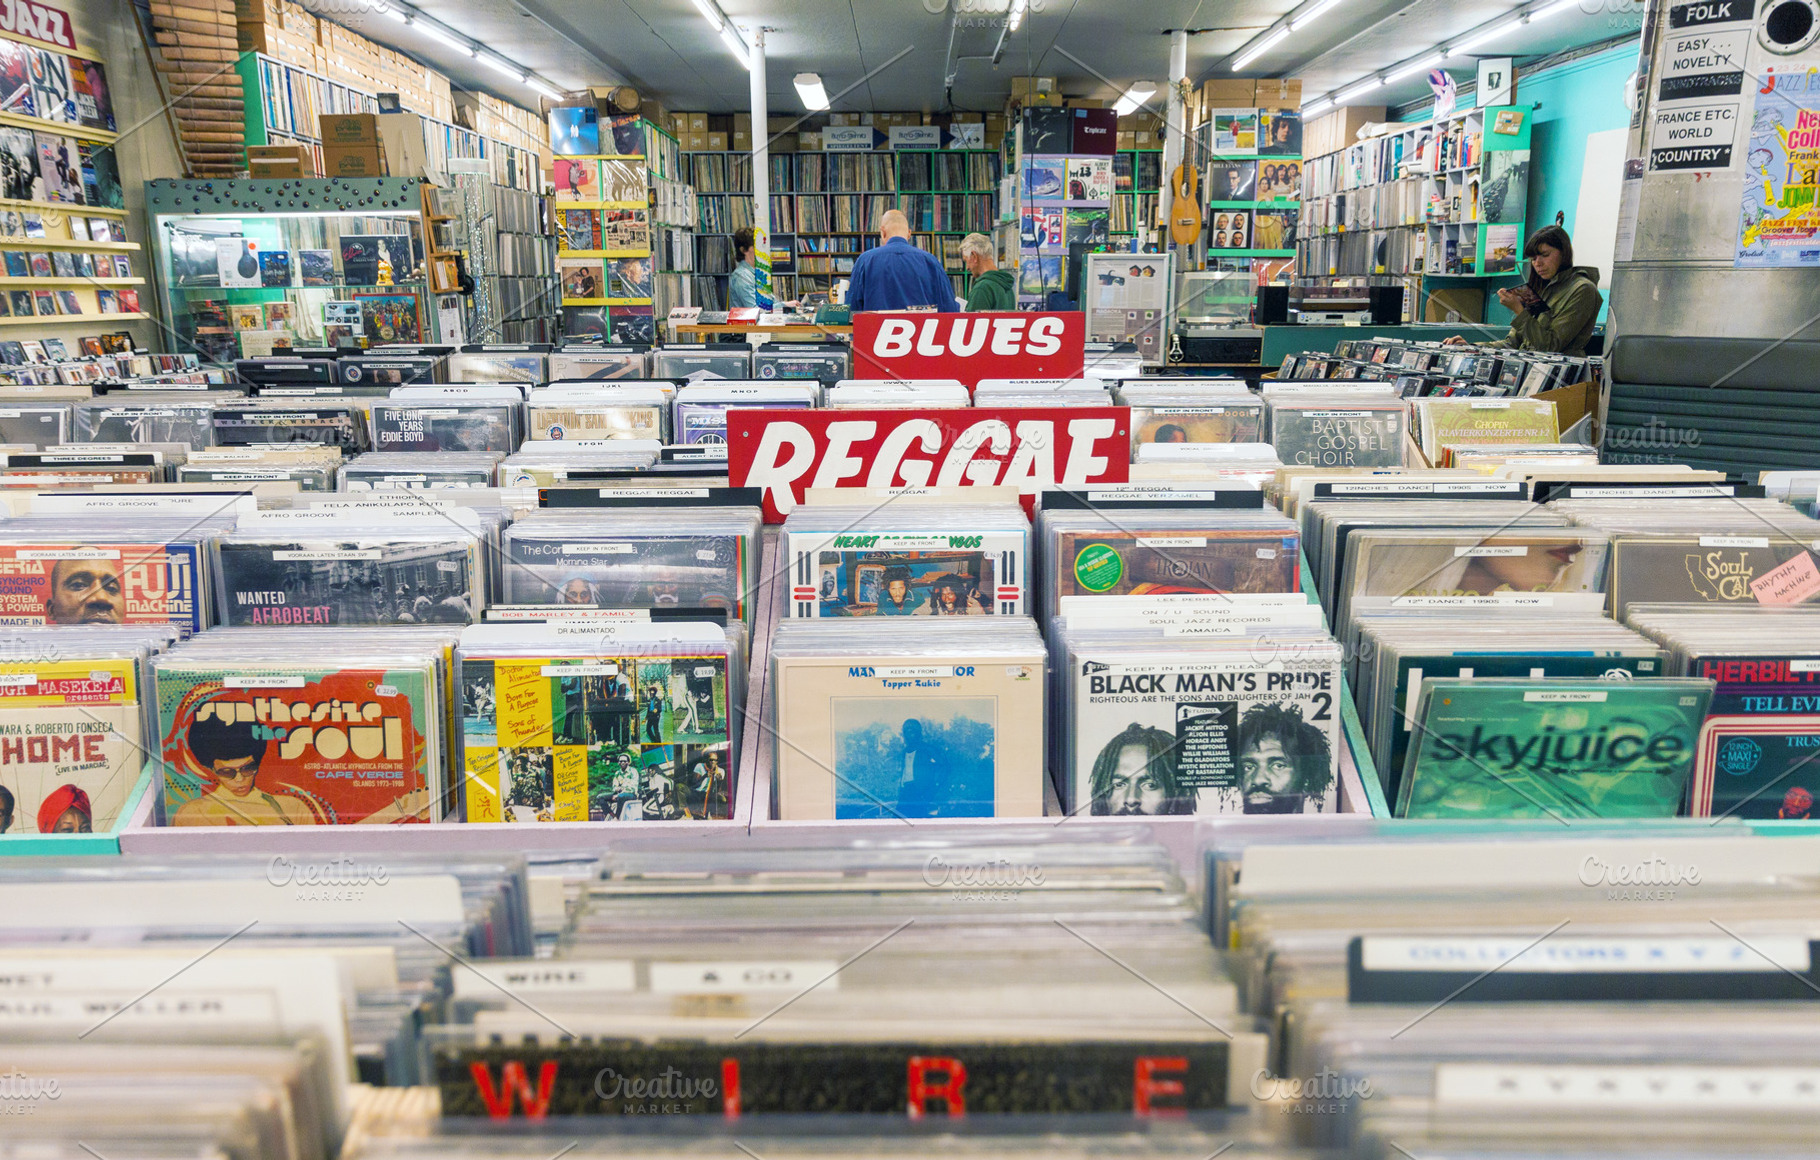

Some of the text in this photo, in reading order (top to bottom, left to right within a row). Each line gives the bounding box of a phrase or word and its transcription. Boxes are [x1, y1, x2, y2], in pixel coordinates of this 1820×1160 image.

[1686, 3, 1732, 22] FOLK
[1, 0, 70, 47] JAZZ
[1677, 38, 1710, 53] EASY
[1673, 54, 1732, 70] NOVELTY
[1657, 109, 1735, 124] FRANCE ETC.
[1083, 126, 1107, 135] Triplicate
[1669, 127, 1713, 140] WORLD
[1657, 148, 1722, 163] COUNTRY
[1789, 151, 1819, 160] Frank
[1079, 166, 1091, 177] 13
[1761, 226, 1794, 234] Groover
[873, 316, 1065, 358] BLUES
[384, 410, 423, 421] FIVE LONG
[398, 421, 424, 432] YEARS
[1312, 419, 1384, 435] BAPTIST
[1474, 420, 1510, 429] CHOPIN
[381, 431, 424, 442] EDDIE BOYD
[1316, 434, 1389, 451] GOSPEL
[1295, 450, 1356, 465] CHOIR
[743, 418, 1115, 515] REGGAE
[833, 535, 880, 549] HEART
[522, 545, 541, 556] The
[556, 558, 609, 567] Morning Star
[0, 577, 45, 586] SYNCHRO
[124, 564, 192, 600] FUJI
[1755, 565, 1797, 593] RHYTHM
[1774, 571, 1812, 599] MACHINE
[0, 585, 33, 595] SOUND
[0, 594, 38, 604] SYSTEM
[236, 590, 286, 605] WANTED
[6, 603, 45, 612] POWER
[126, 600, 194, 613] MACHINE
[253, 606, 331, 625] AFROBEAT
[569, 627, 616, 635] ALIMANTADO
[499, 667, 524, 675] Doctor
[37, 679, 123, 695] MASEKELA
[882, 679, 942, 690] Tapper Zukie
[1090, 671, 1332, 694] BLACK MAN'S PRIDE
[65, 693, 110, 702] presents
[505, 691, 536, 704] Born For
[1090, 695, 1142, 704] RIGHTEOUS
[1160, 695, 1176, 703] THE
[1178, 695, 1203, 703] SONS
[1204, 694, 1224, 702] AND
[1227, 693, 1278, 702] DAUGHTERS
[1294, 692, 1312, 700] JAH
[1741, 696, 1789, 712] TELL
[196, 696, 382, 727] synthesize
[1310, 692, 1332, 721] 2
[526, 714, 537, 725] of
[25, 723, 32, 735] &
[35, 722, 74, 735] ROBERTO
[76, 721, 115, 734] FONSECA
[251, 724, 287, 741] the
[512, 725, 546, 739] Thunder
[278, 715, 404, 760] soul
[2, 734, 106, 765] HOME
[1432, 725, 1684, 771] skyjuice
[1728, 752, 1752, 761] MAXI
[304, 762, 404, 771] ASTRO-ATLANTIC HYPNOTICA FROM THE
[1727, 761, 1750, 770] SINGLE
[315, 770, 404, 780] CAPE VERDE
[504, 970, 586, 985] WIRE
